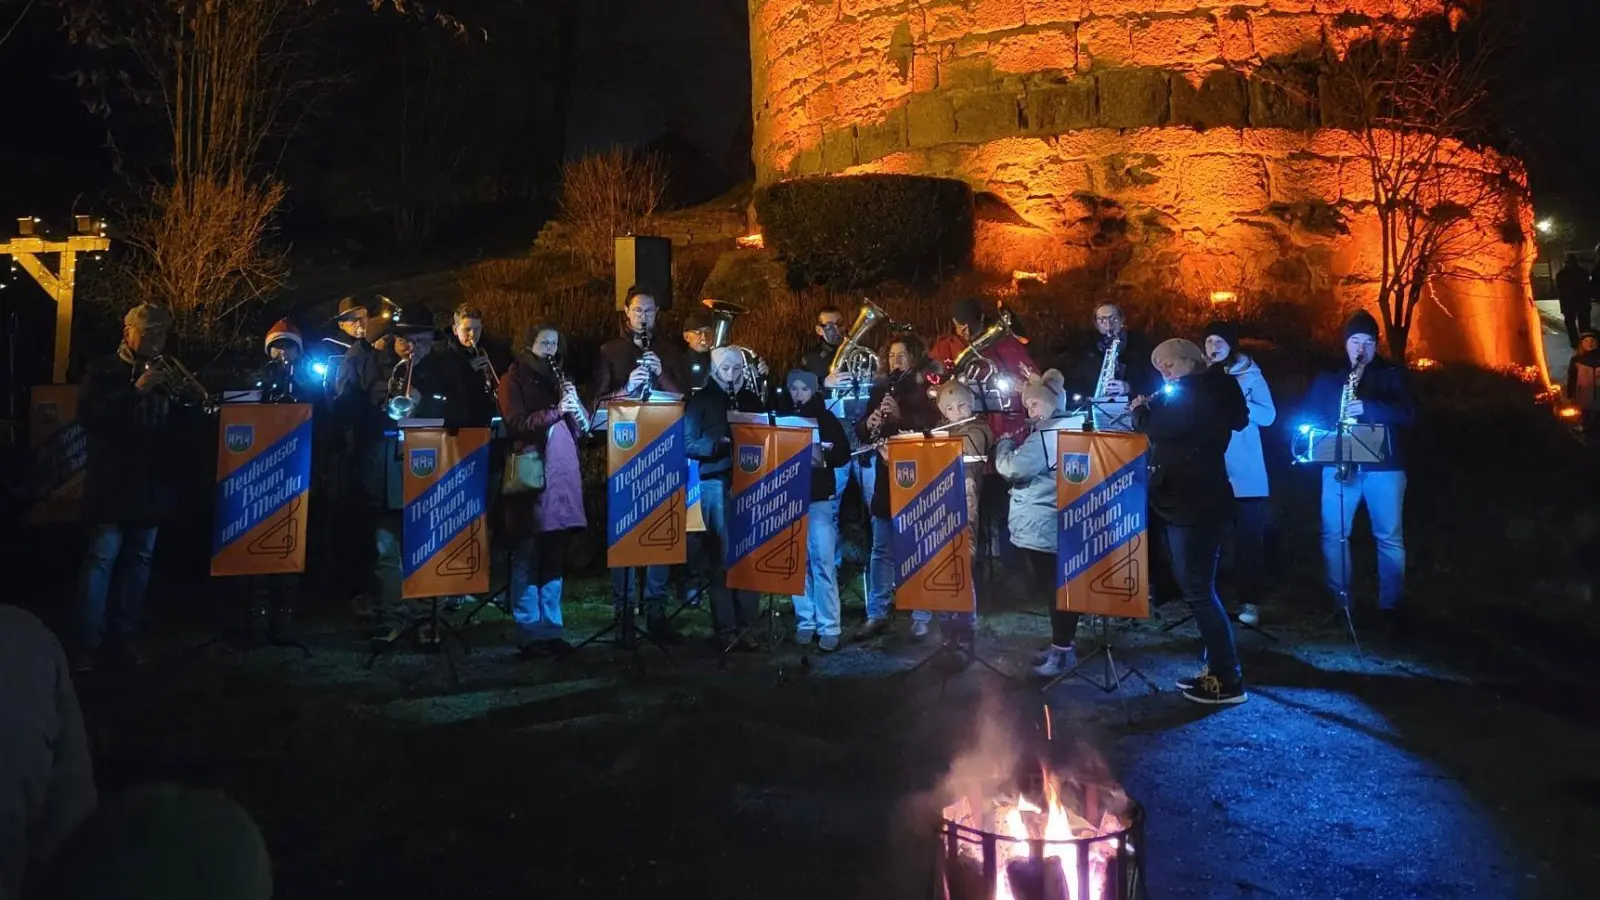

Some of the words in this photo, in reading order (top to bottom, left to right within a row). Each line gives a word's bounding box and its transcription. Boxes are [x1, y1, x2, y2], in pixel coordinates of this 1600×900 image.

[224, 437, 299, 499] Neuhauser
[242, 467, 284, 508] Boum
[411, 461, 476, 522] Neuhauser
[615, 434, 675, 493] Neuhauser
[631, 463, 664, 501] Boum
[736, 461, 800, 515] Neuhauser
[221, 508, 248, 543] und
[253, 475, 301, 520] Moidla
[429, 490, 465, 529] Boum
[615, 502, 638, 535] und
[640, 470, 680, 514] Moidla
[735, 526, 756, 558] und
[760, 499, 803, 539] Moidla
[751, 490, 787, 525] Boum
[898, 472, 955, 534] Neuhauser
[914, 503, 946, 542] Boum
[1063, 470, 1135, 531] Neuhauser
[1081, 502, 1122, 541] Boum
[412, 531, 436, 566] und
[439, 498, 481, 542] Moidla
[901, 545, 921, 578] und
[924, 511, 961, 556] Moidla
[1064, 543, 1088, 576] und
[1093, 512, 1140, 556] Moidla
